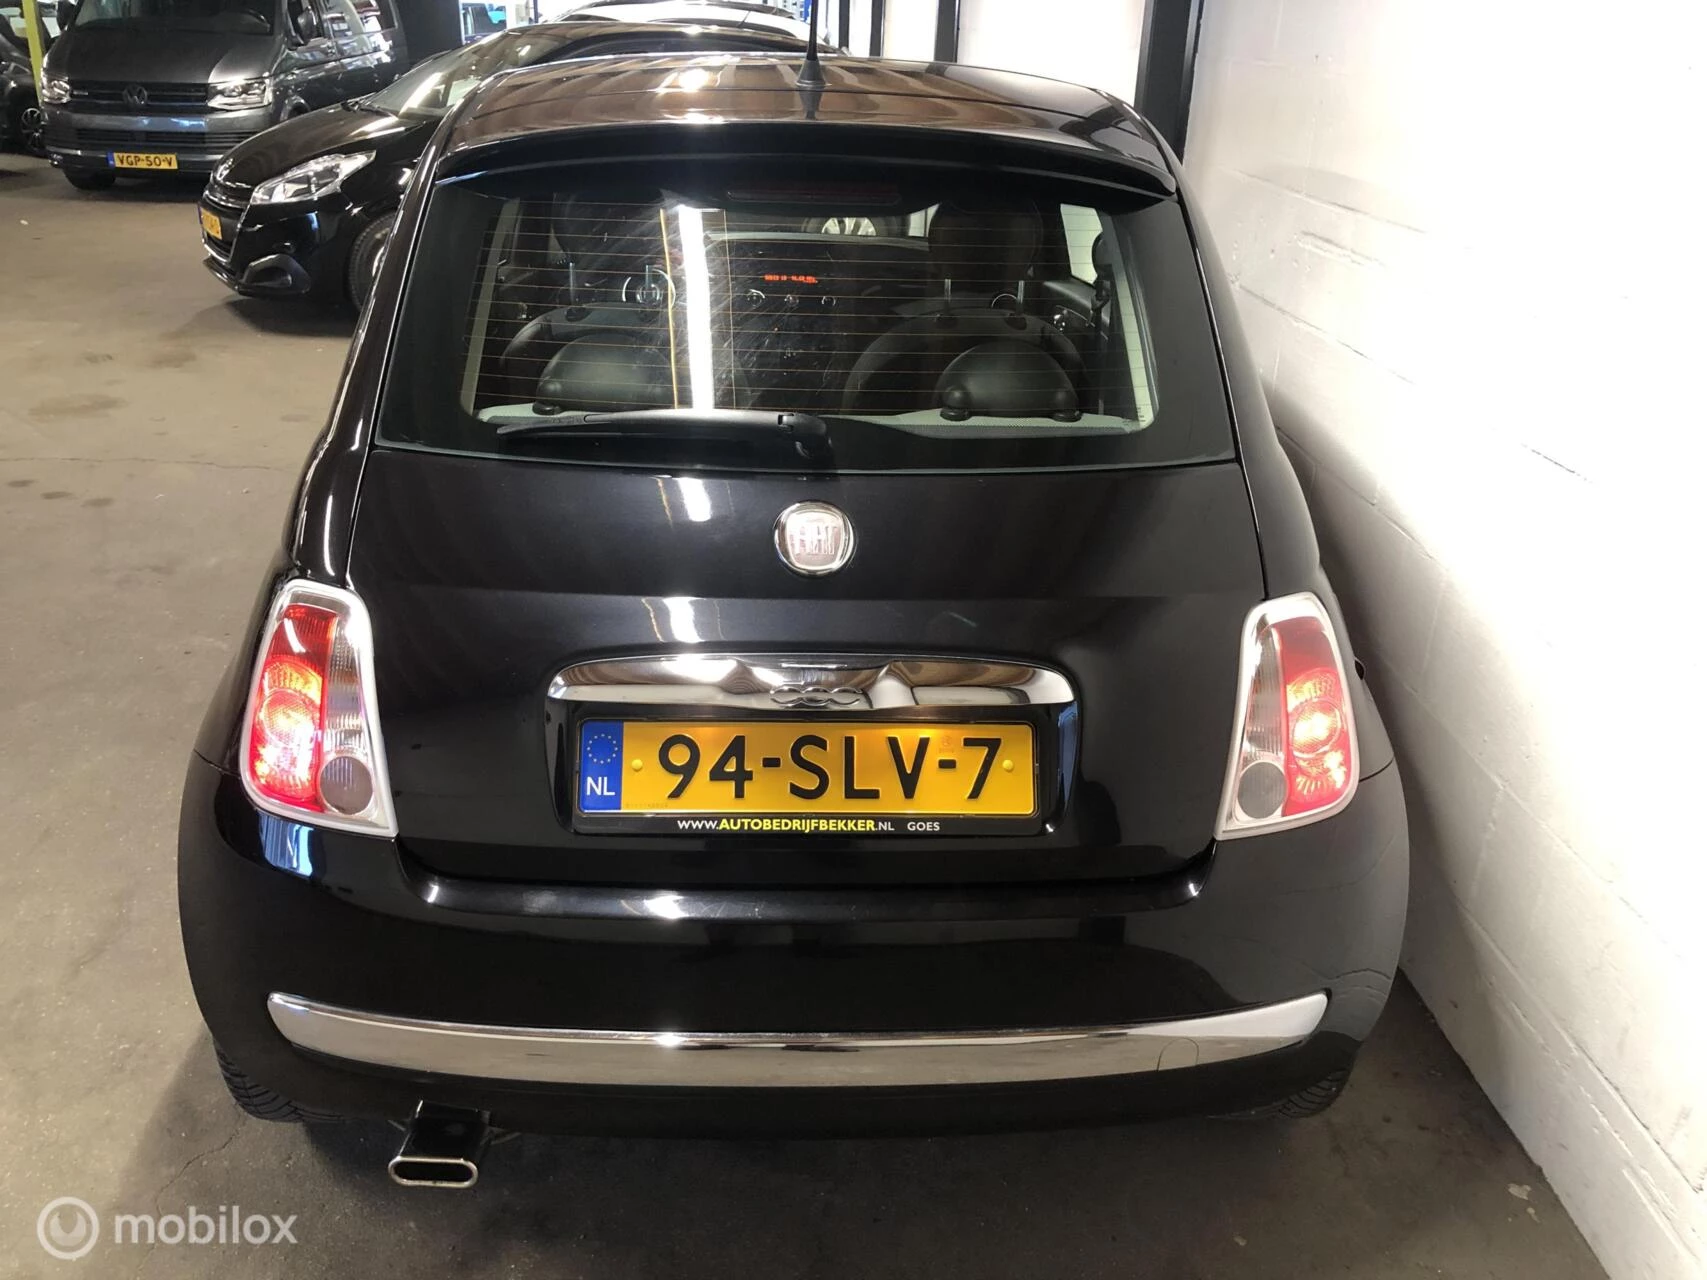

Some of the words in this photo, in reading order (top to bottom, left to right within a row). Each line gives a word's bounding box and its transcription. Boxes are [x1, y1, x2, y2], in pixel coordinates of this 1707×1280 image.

[117, 154, 173, 167] VGP-50-V
[658, 734, 1002, 800] 94-SLV-7
[586, 776, 616, 796] NL
[907, 821, 941, 831] GOES
